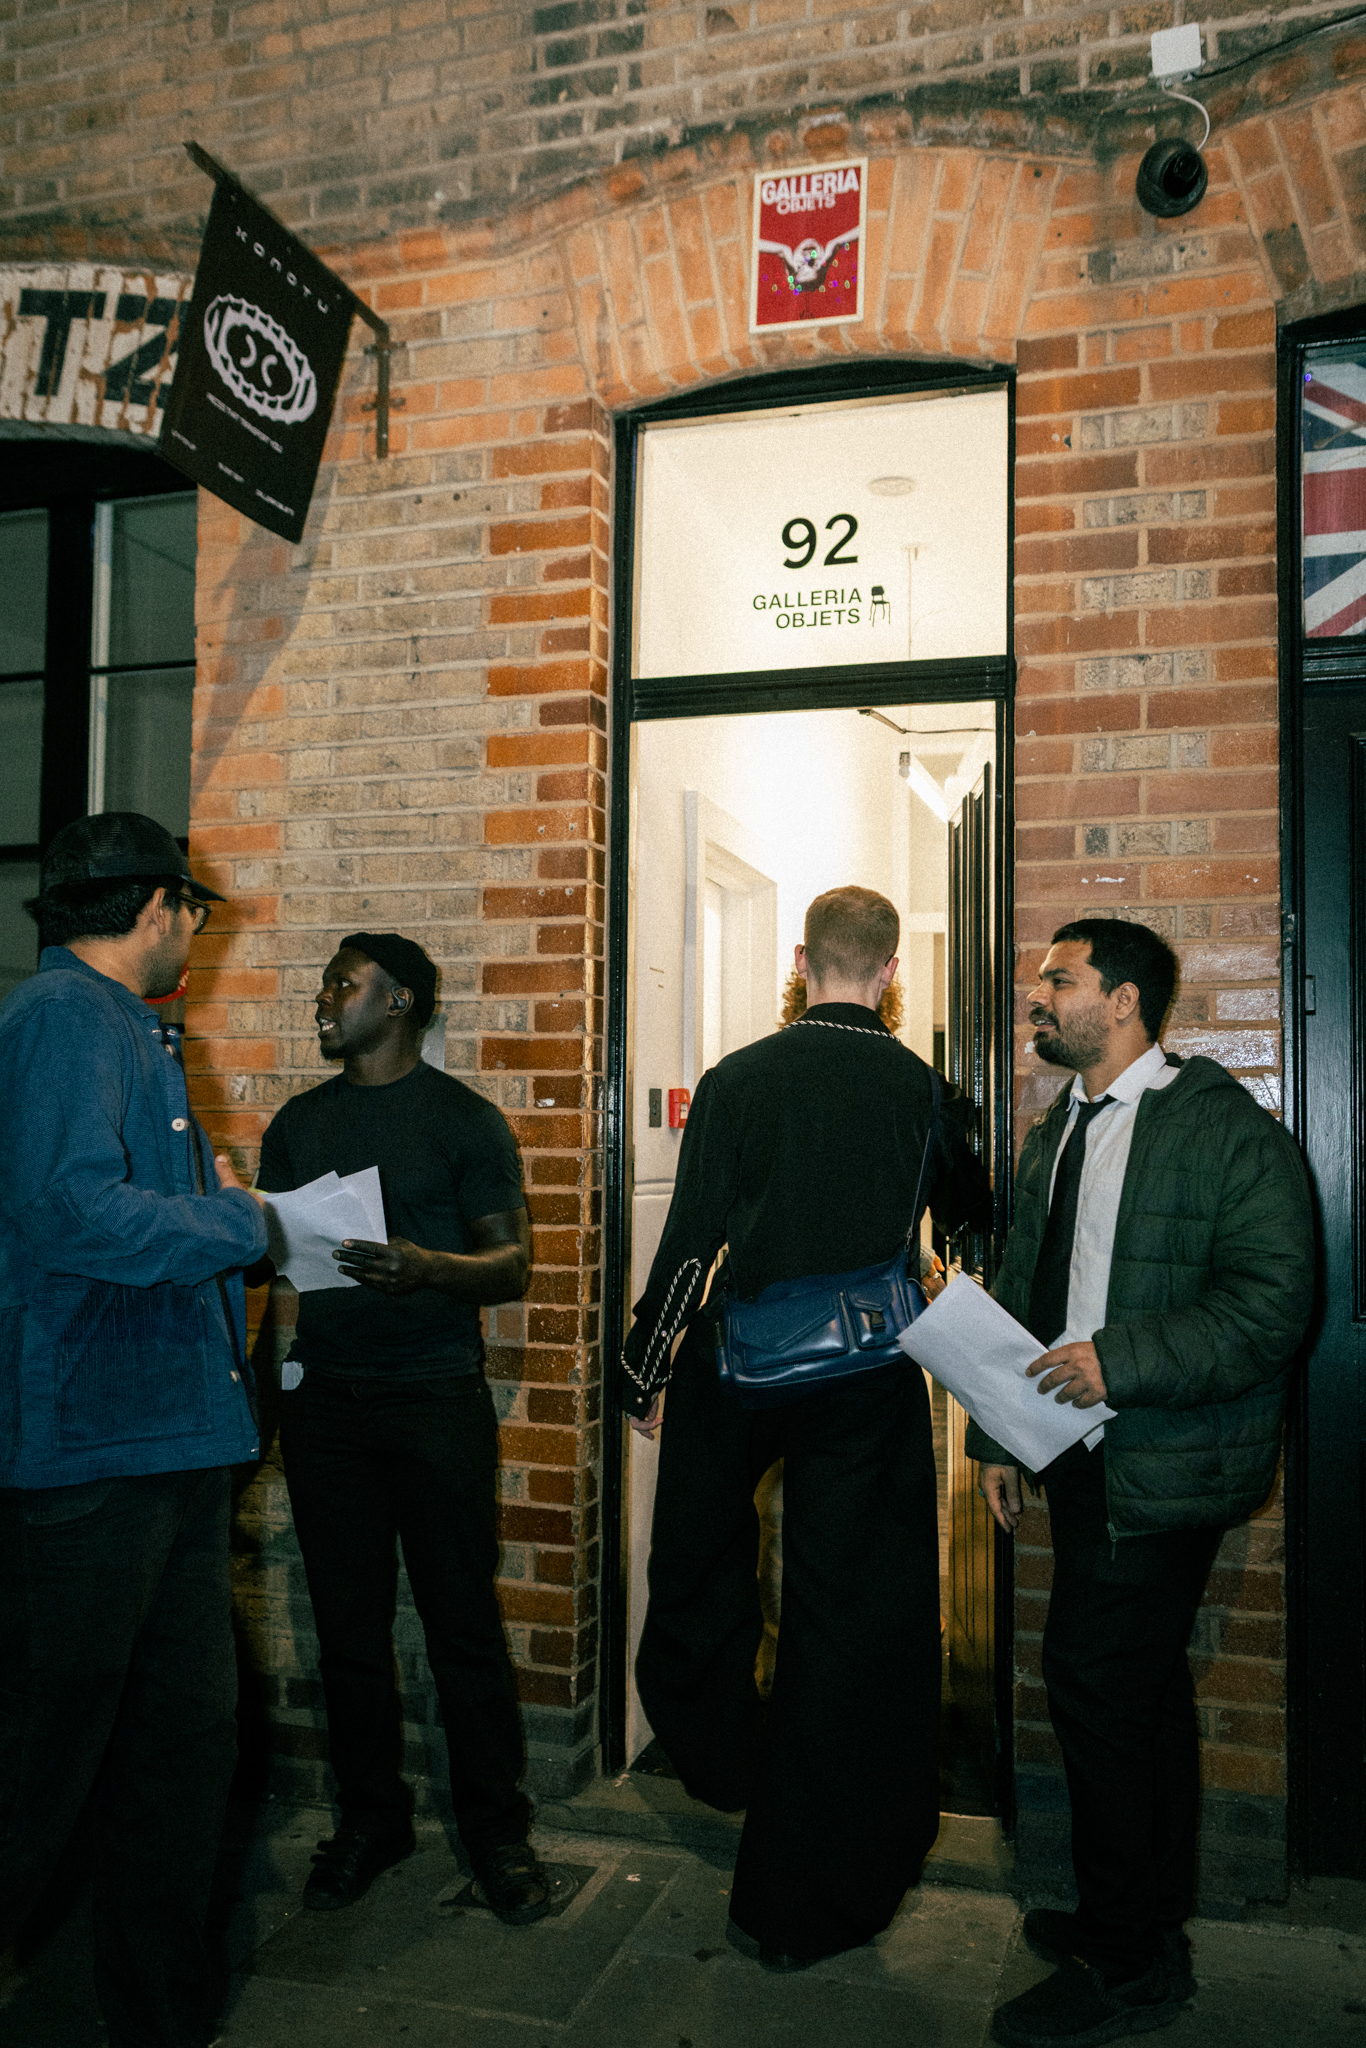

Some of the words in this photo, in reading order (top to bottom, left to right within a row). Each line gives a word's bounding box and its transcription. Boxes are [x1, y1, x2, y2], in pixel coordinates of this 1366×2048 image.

[762, 169, 859, 204] GALLERIA
[777, 193, 836, 214] OBJETS
[781, 513, 859, 569] 92
[753, 588, 862, 610] GALLERIA
[776, 608, 860, 629] OBJETS
